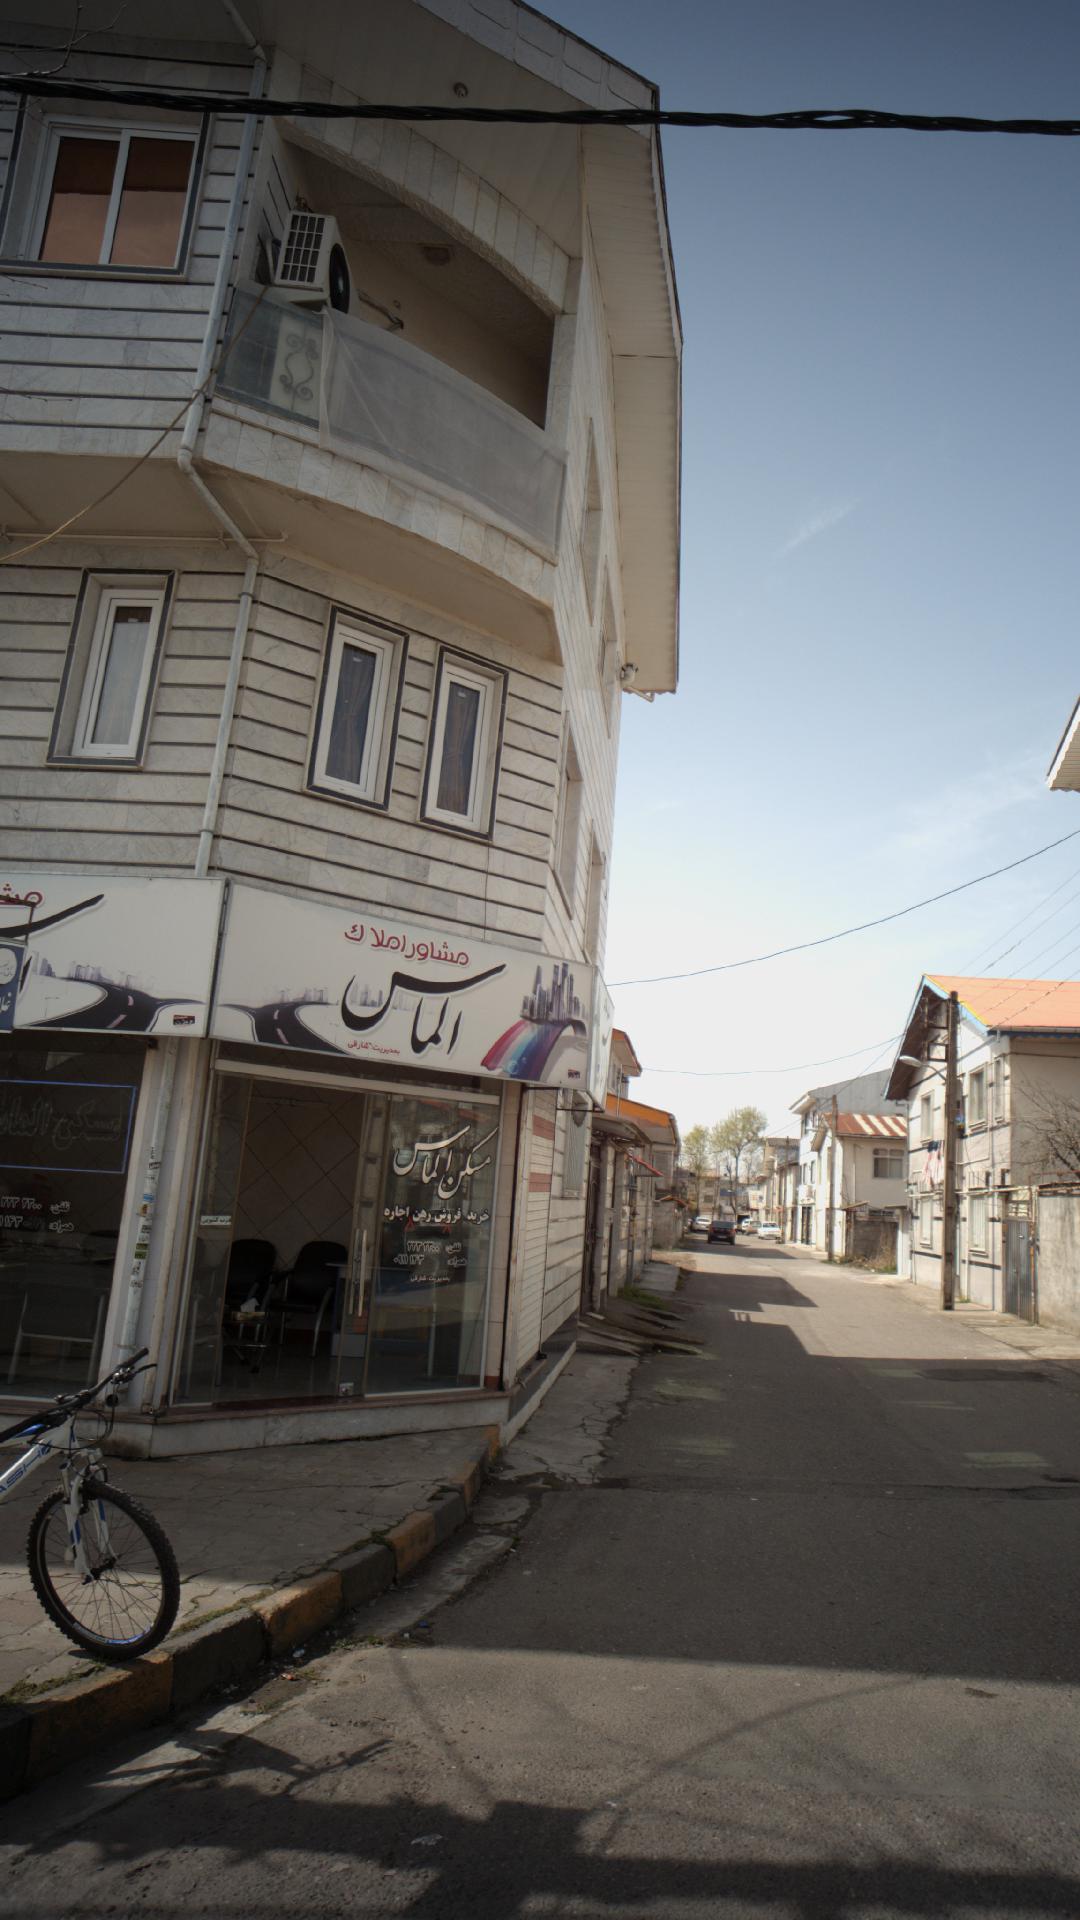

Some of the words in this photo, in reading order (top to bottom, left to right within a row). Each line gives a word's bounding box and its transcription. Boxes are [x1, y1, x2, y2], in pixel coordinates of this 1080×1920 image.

[341, 963, 507, 1056] الماس
[393, 1125, 471, 1184] الماس
[438, 1126, 499, 1200] مسکن
[383, 1205, 410, 1221] اجاره
[412, 1208, 432, 1223] رهن
[434, 1207, 462, 1224] فروش
[467, 1209, 490, 1225] خرید
